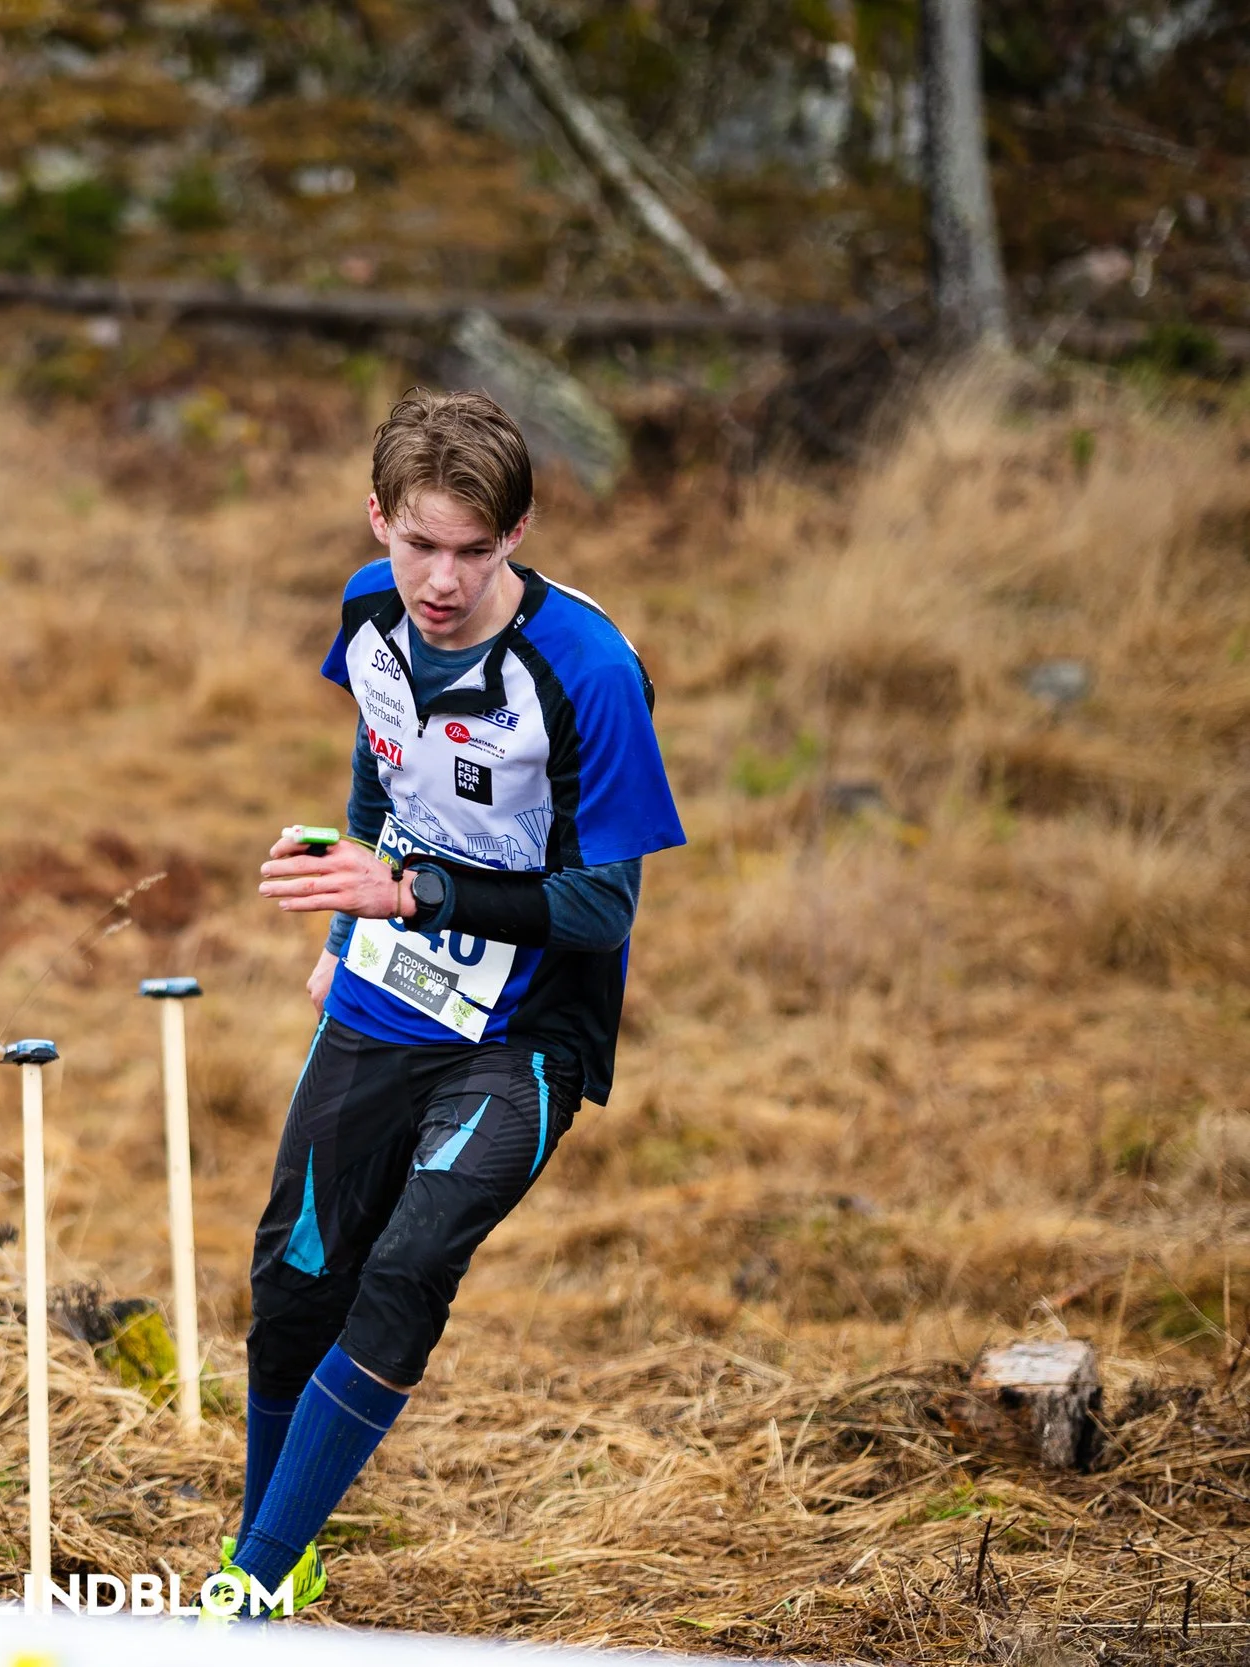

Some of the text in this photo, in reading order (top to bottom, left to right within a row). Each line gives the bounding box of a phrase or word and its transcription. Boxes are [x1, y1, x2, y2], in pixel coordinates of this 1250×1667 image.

[371, 649, 402, 681] SSAB
[365, 680, 405, 715] Sörmlands
[365, 696, 402, 729] Sparbank
[458, 760, 479, 776] PER
[458, 770, 479, 785] FOR
[458, 779, 476, 792] MA
[392, 962, 445, 997] AVLOPP
[397, 951, 450, 986] GODKÄNDA
